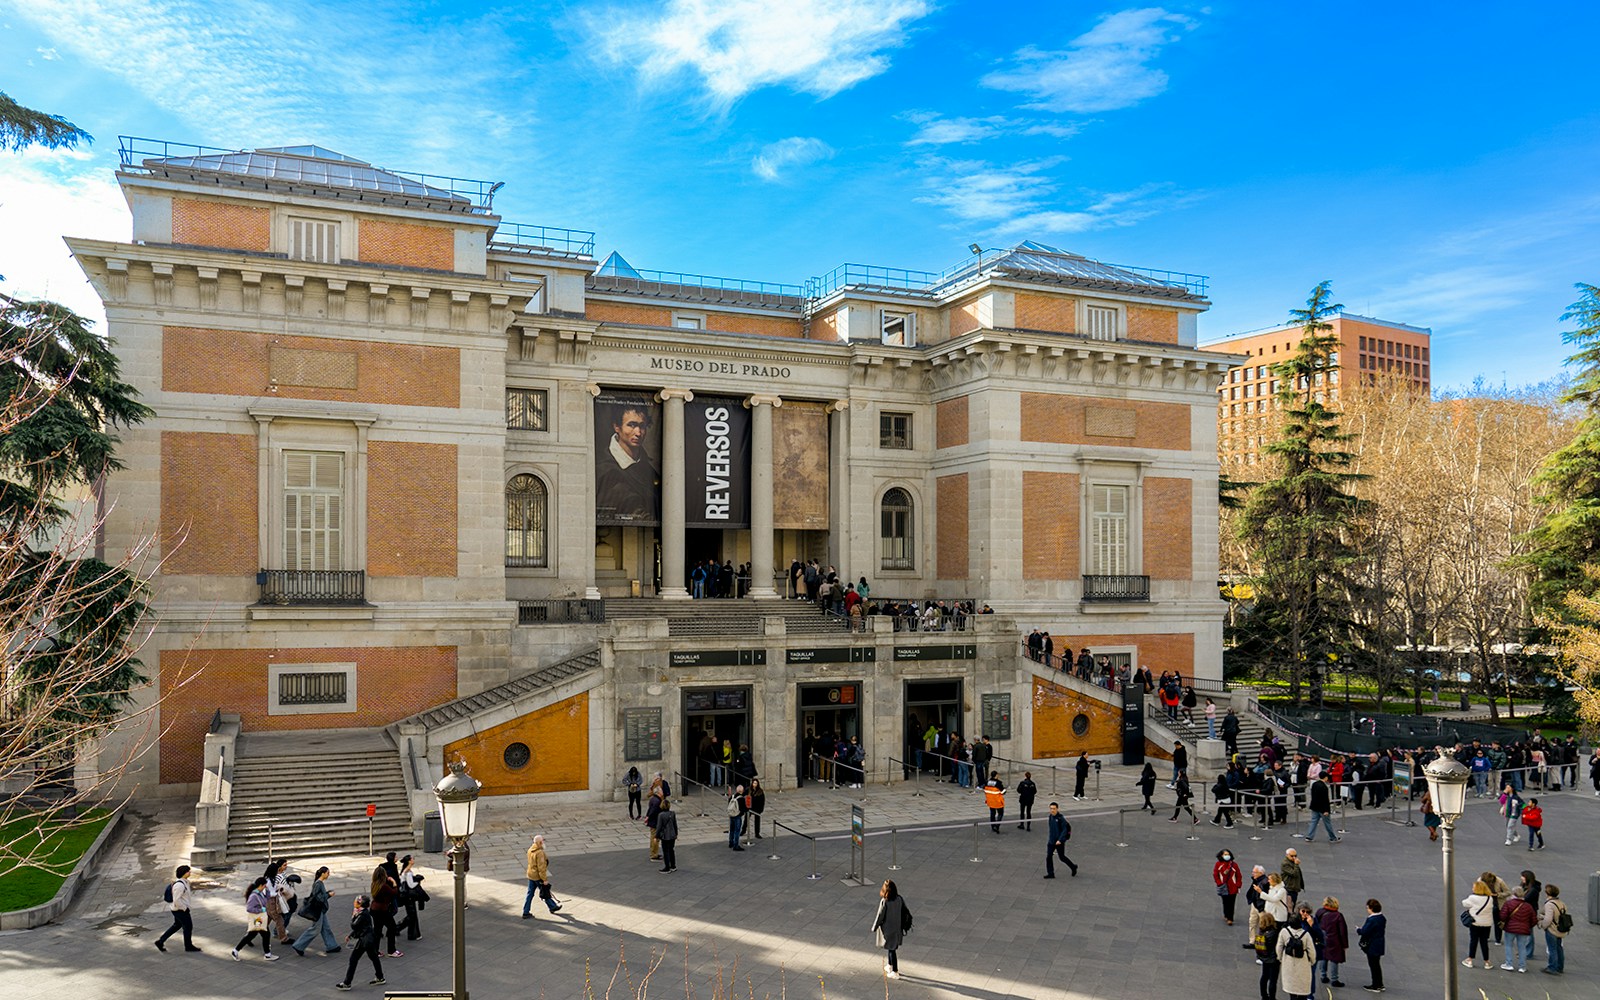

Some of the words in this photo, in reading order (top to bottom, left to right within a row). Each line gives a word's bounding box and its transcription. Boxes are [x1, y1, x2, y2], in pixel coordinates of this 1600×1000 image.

[650, 357, 704, 372] MUSEO
[709, 362, 738, 375] DEL
[742, 364, 791, 378] PRADO
[705, 407, 730, 519] REVERSOS
